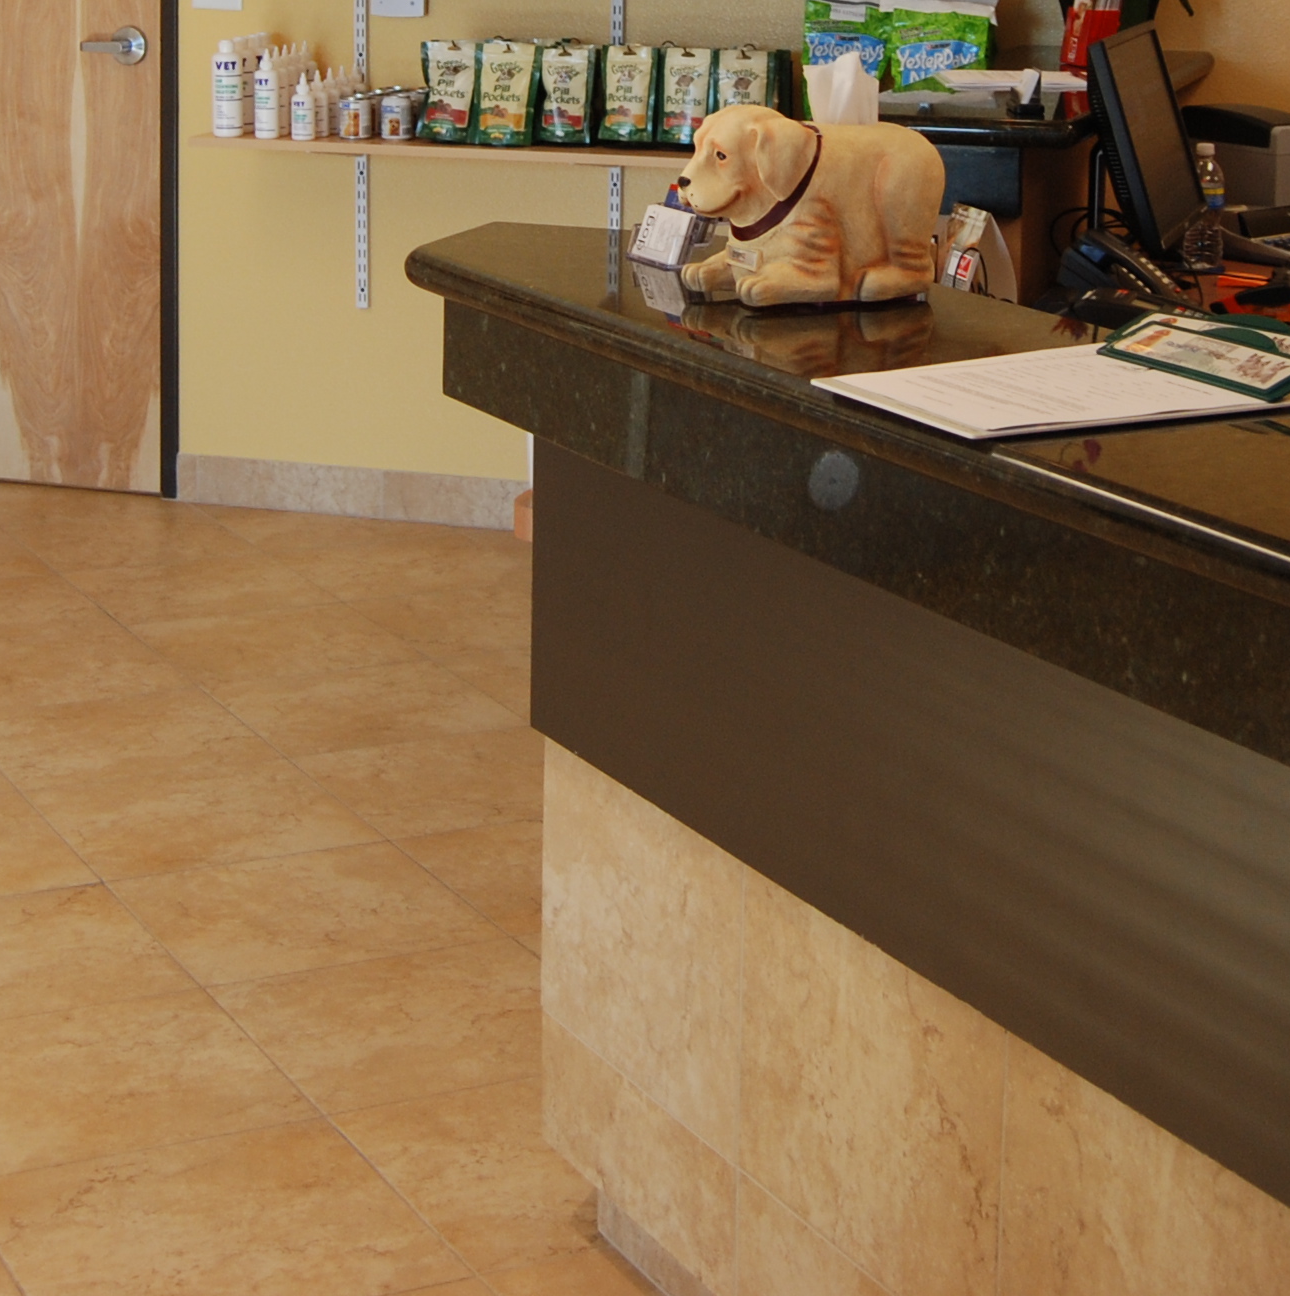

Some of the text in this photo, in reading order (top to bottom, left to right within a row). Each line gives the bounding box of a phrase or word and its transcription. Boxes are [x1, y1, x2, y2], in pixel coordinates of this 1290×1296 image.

[215, 61, 238, 71] VET
[437, 78, 456, 88] Pill
[494, 84, 511, 93] Pill
[552, 86, 570, 95] Pill
[616, 85, 633, 94] Pill
[675, 87, 692, 97] Pill
[733, 90, 751, 100] Pill
